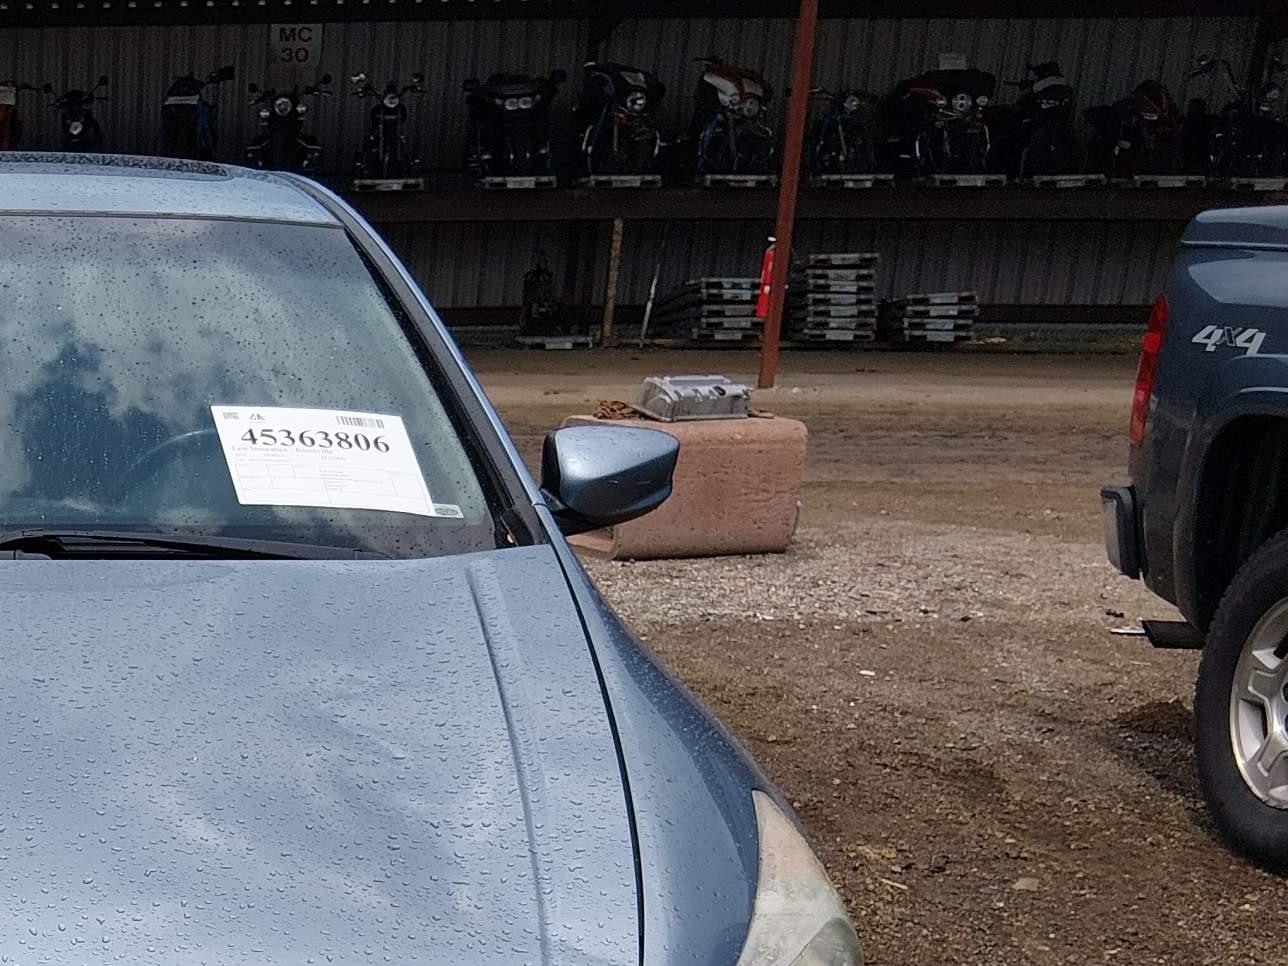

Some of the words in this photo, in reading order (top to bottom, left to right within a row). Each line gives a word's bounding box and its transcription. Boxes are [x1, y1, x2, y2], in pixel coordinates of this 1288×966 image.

[279, 27, 313, 42] MC
[280, 47, 309, 63] 30
[240, 427, 391, 454] 45363806
